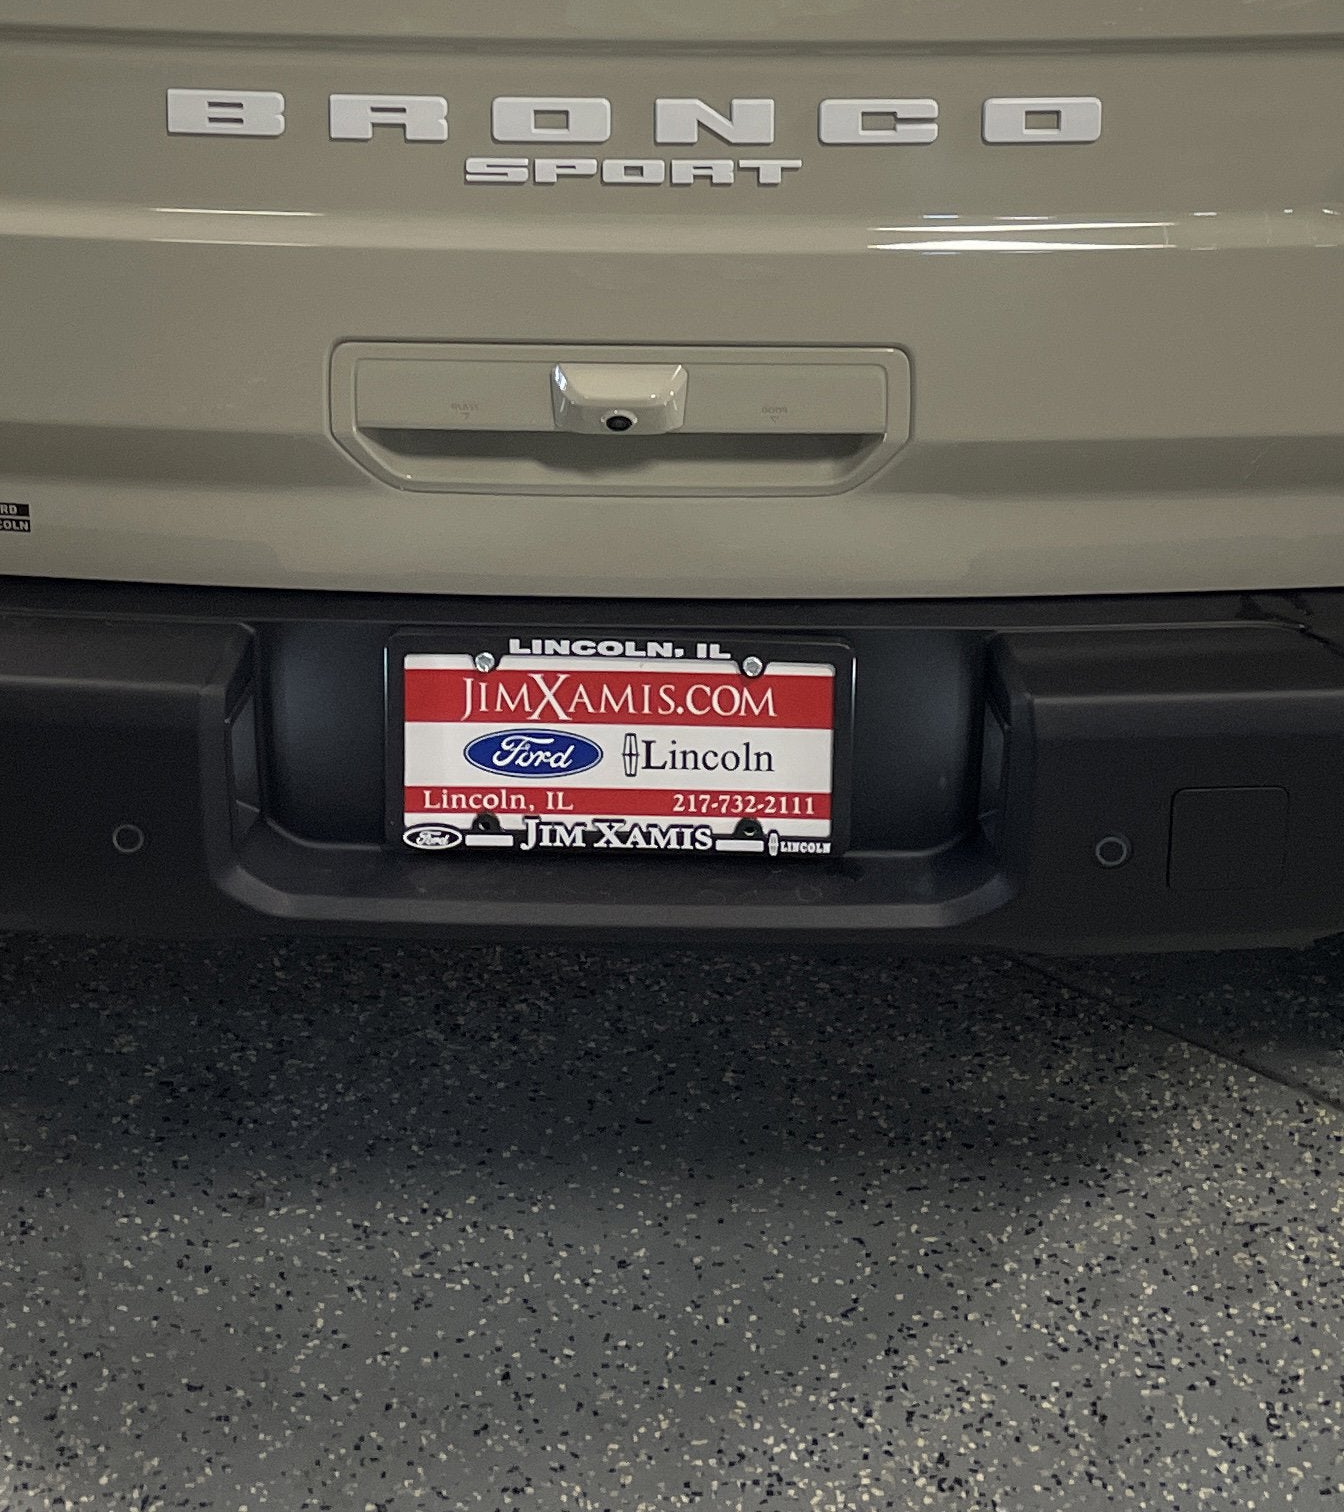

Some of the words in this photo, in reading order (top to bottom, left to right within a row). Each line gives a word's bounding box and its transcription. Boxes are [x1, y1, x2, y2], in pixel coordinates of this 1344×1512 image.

[166, 88, 1102, 144] BRONCO
[464, 157, 802, 185] SPORT
[509, 638, 683, 658] LINCOLN,
[696, 643, 731, 659] IL
[492, 735, 574, 768] Ford
[642, 740, 774, 772] Lincoln
[423, 790, 533, 812] Lincoln,
[546, 791, 574, 811] IL
[672, 794, 814, 814] 217-732-2111
[416, 831, 450, 846] Ford
[521, 818, 586, 849] JIM
[594, 823, 712, 849] XAMIS
[780, 840, 830, 853] LINCOLN
